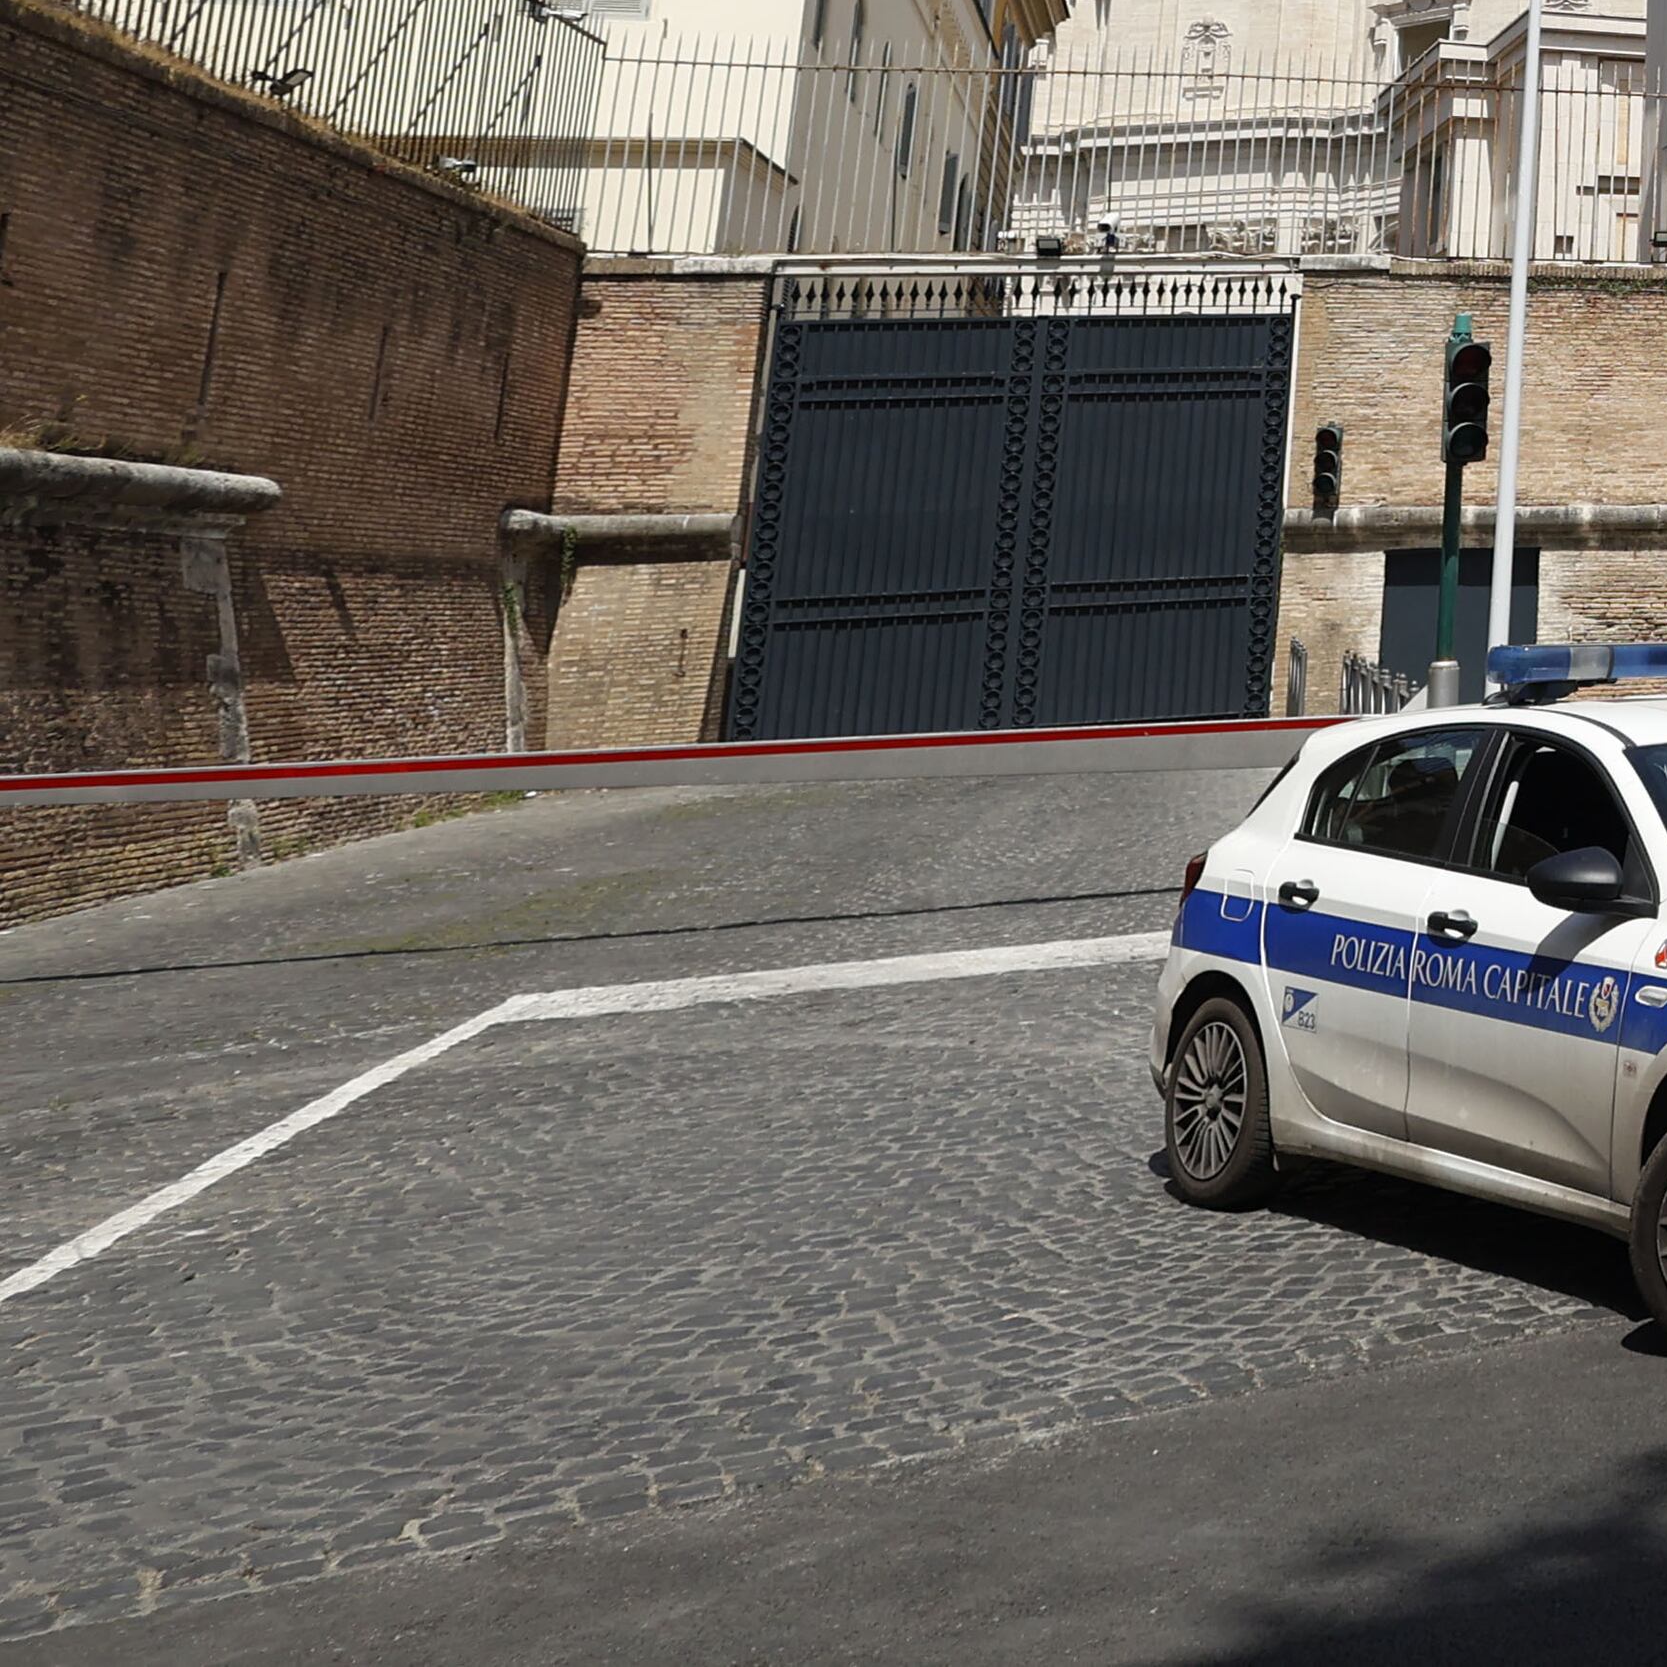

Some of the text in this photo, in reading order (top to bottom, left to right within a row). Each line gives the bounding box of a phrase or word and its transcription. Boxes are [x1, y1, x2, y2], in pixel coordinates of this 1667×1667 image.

[1330, 933, 1590, 1019] POLIZIA ROMA CAPITALE
